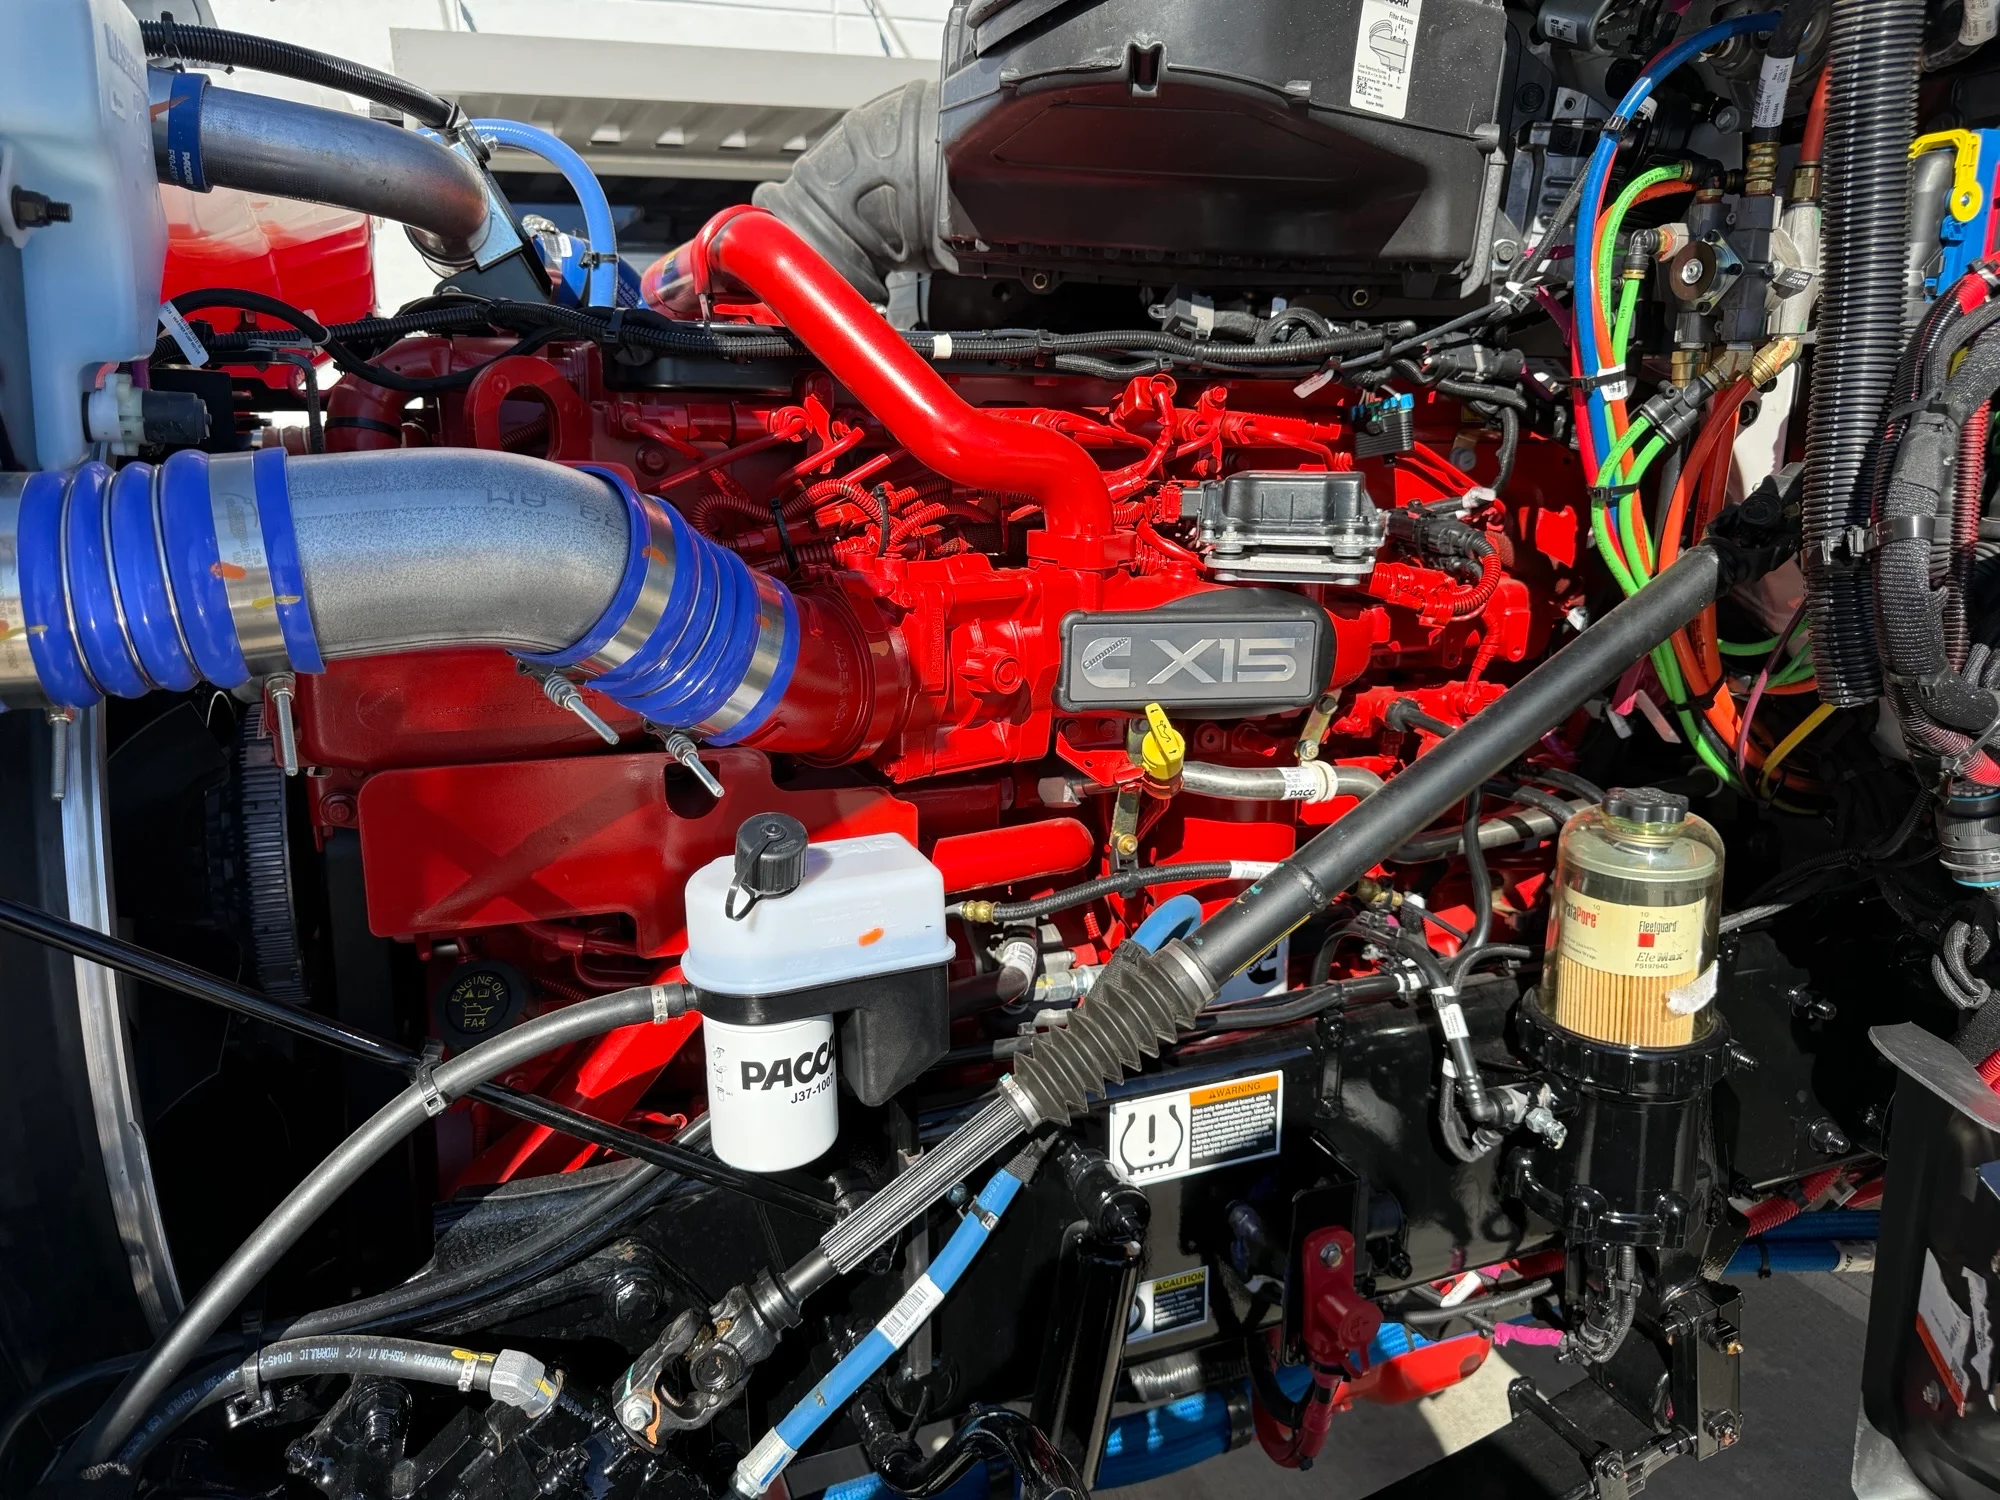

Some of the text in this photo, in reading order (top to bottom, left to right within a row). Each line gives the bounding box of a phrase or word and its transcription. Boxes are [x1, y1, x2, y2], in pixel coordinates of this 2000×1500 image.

[1388, 12, 1414, 24] Filter Access
[1082, 636, 1128, 671] Cummins
[1147, 638, 1297, 685] X15
[1638, 920, 1678, 935] Fleetguard
[452, 976, 504, 1002] ENGINE OIL
[464, 1018, 486, 1028] FA4
[741, 1032, 834, 1090] PACCA
[1215, 1082, 1261, 1098] WARNING
[1162, 1271, 1205, 1289] CAUTION
[299, 1346, 339, 1359] HYDRAULIC
